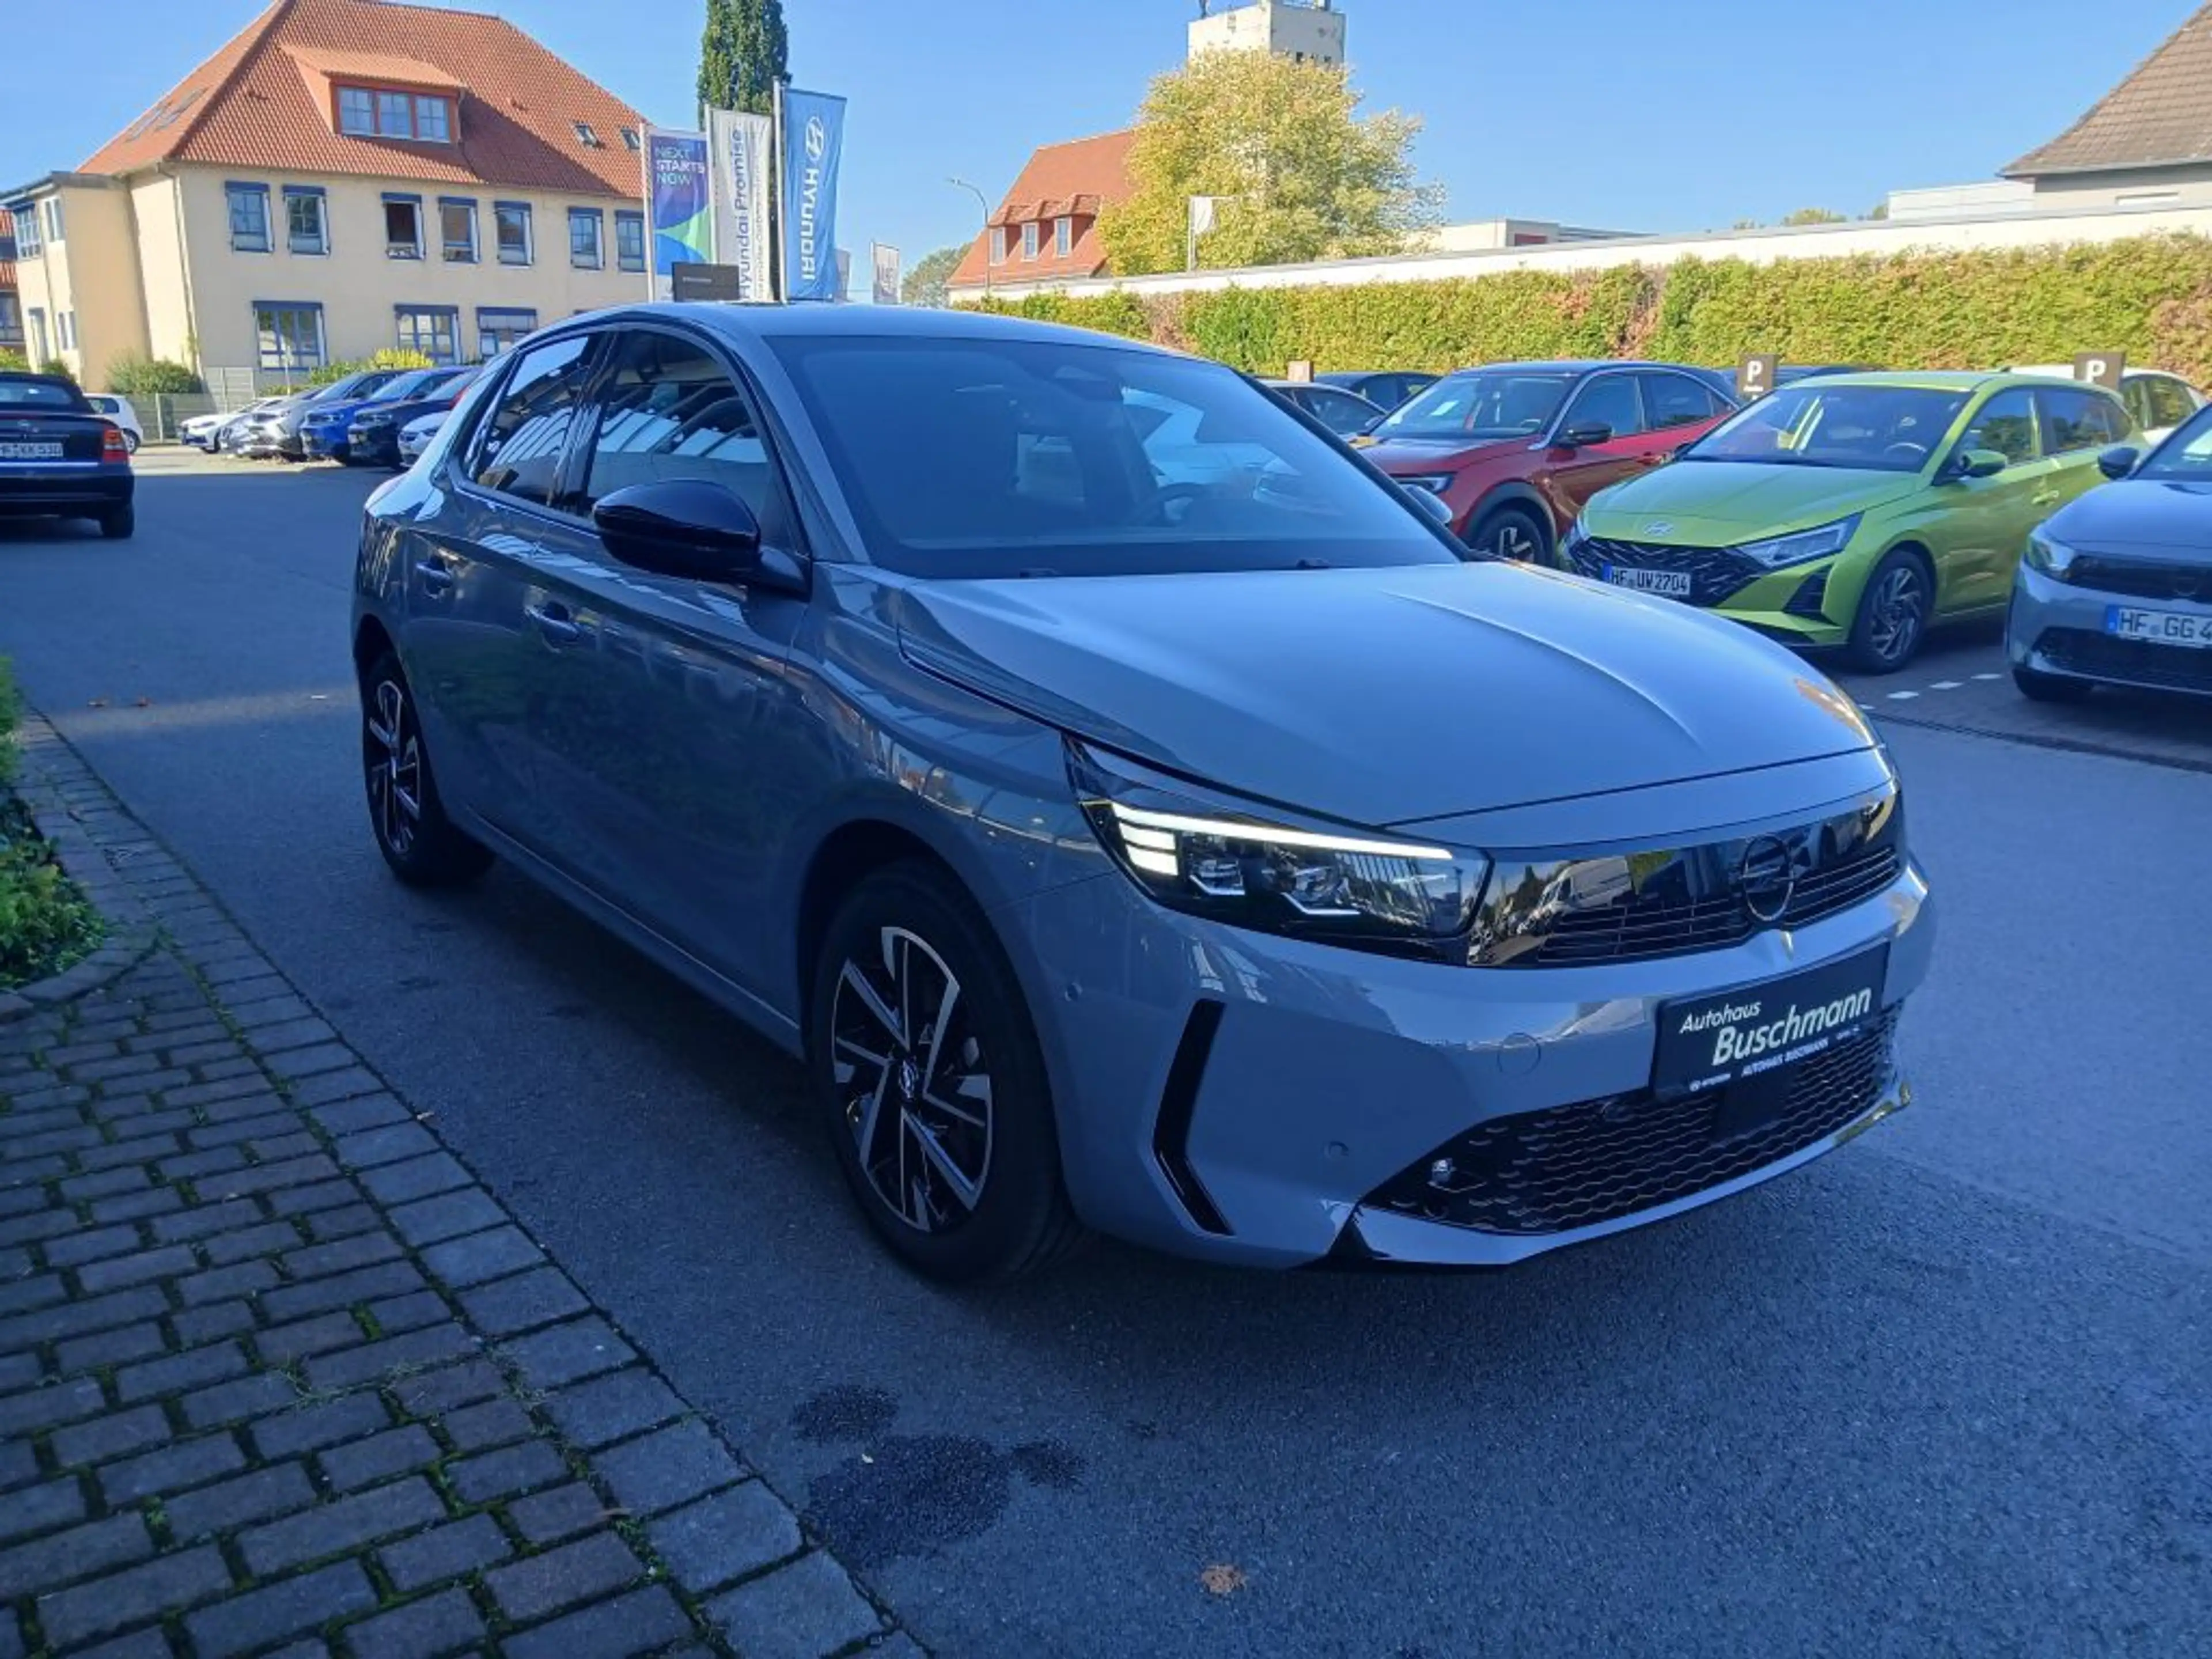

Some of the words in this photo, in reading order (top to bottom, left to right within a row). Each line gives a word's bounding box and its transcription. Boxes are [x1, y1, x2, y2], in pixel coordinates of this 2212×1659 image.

[656, 146, 691, 159] NEXT
[656, 160, 704, 174] STARTS
[657, 172, 691, 185] NOW
[732, 129, 748, 210] Promise
[801, 168, 820, 280] HYUNDAI
[735, 215, 752, 298] Hyundai
[1748, 360, 1763, 382] P
[2086, 359, 2107, 383] P
[2119, 611, 2150, 632] HF
[1679, 1001, 1762, 1035] Autohaus
[1711, 987, 1872, 1066] Buschmann
